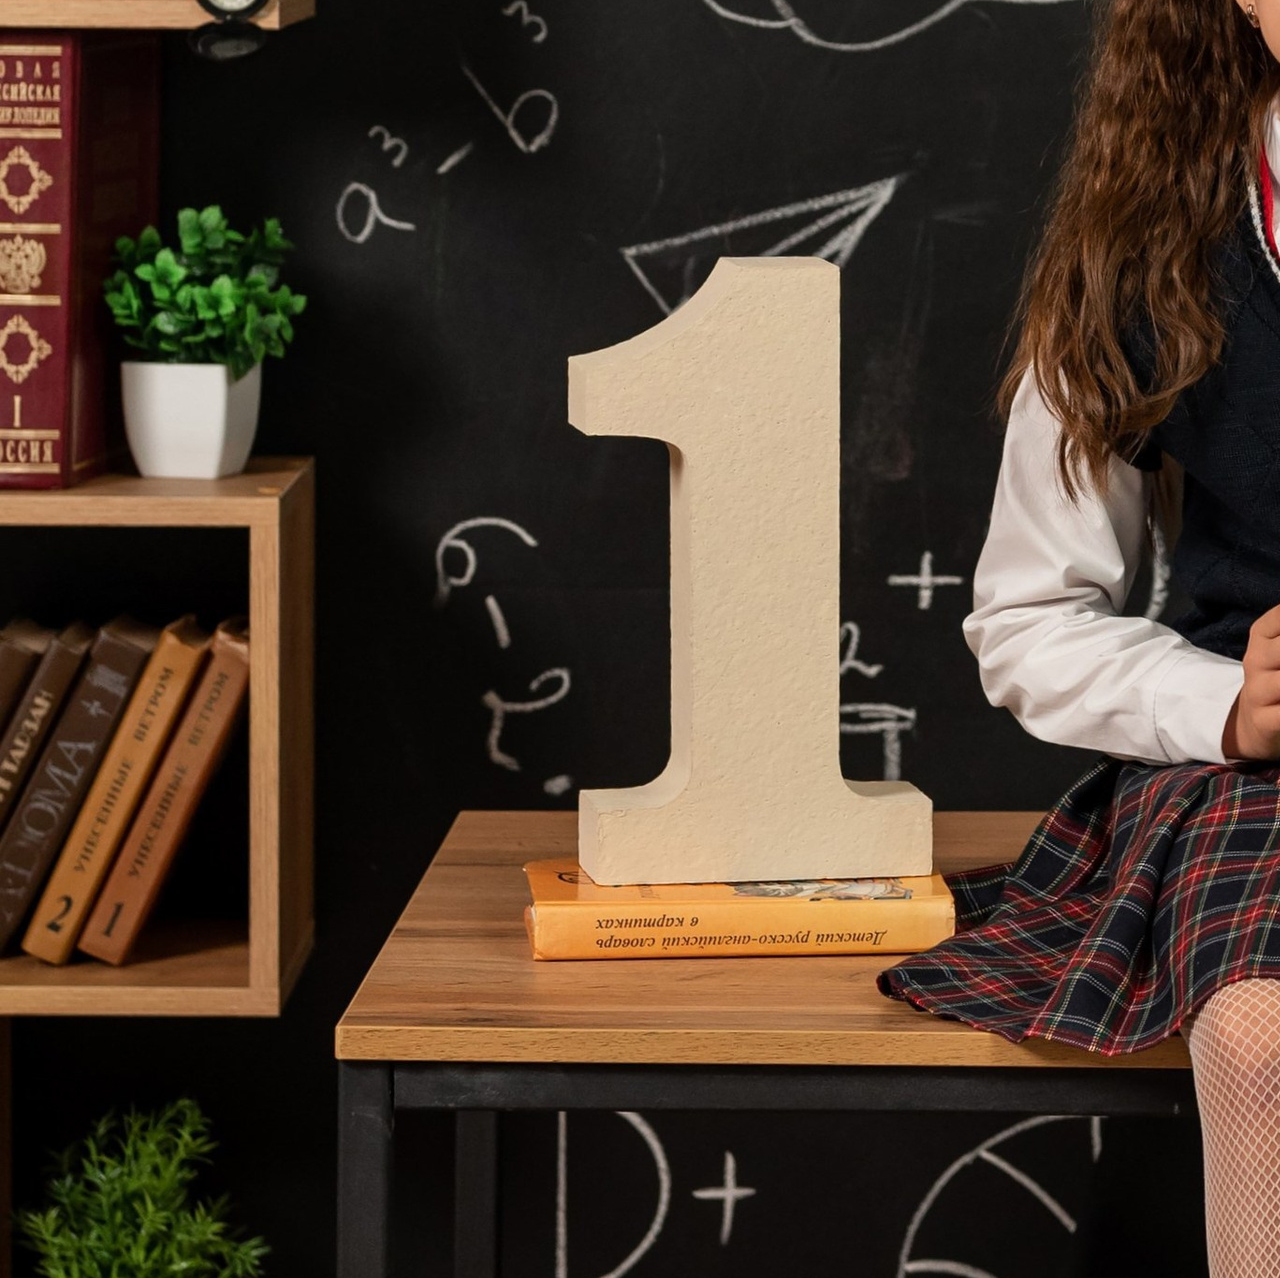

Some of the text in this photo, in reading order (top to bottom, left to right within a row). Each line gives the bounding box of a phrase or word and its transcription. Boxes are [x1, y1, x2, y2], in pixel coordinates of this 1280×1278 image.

[46, 895, 73, 933] 2
[103, 902, 124, 938] 1
[595, 913, 699, 930] в картинках
[595, 930, 888, 952] Детский русско-английский словарь
